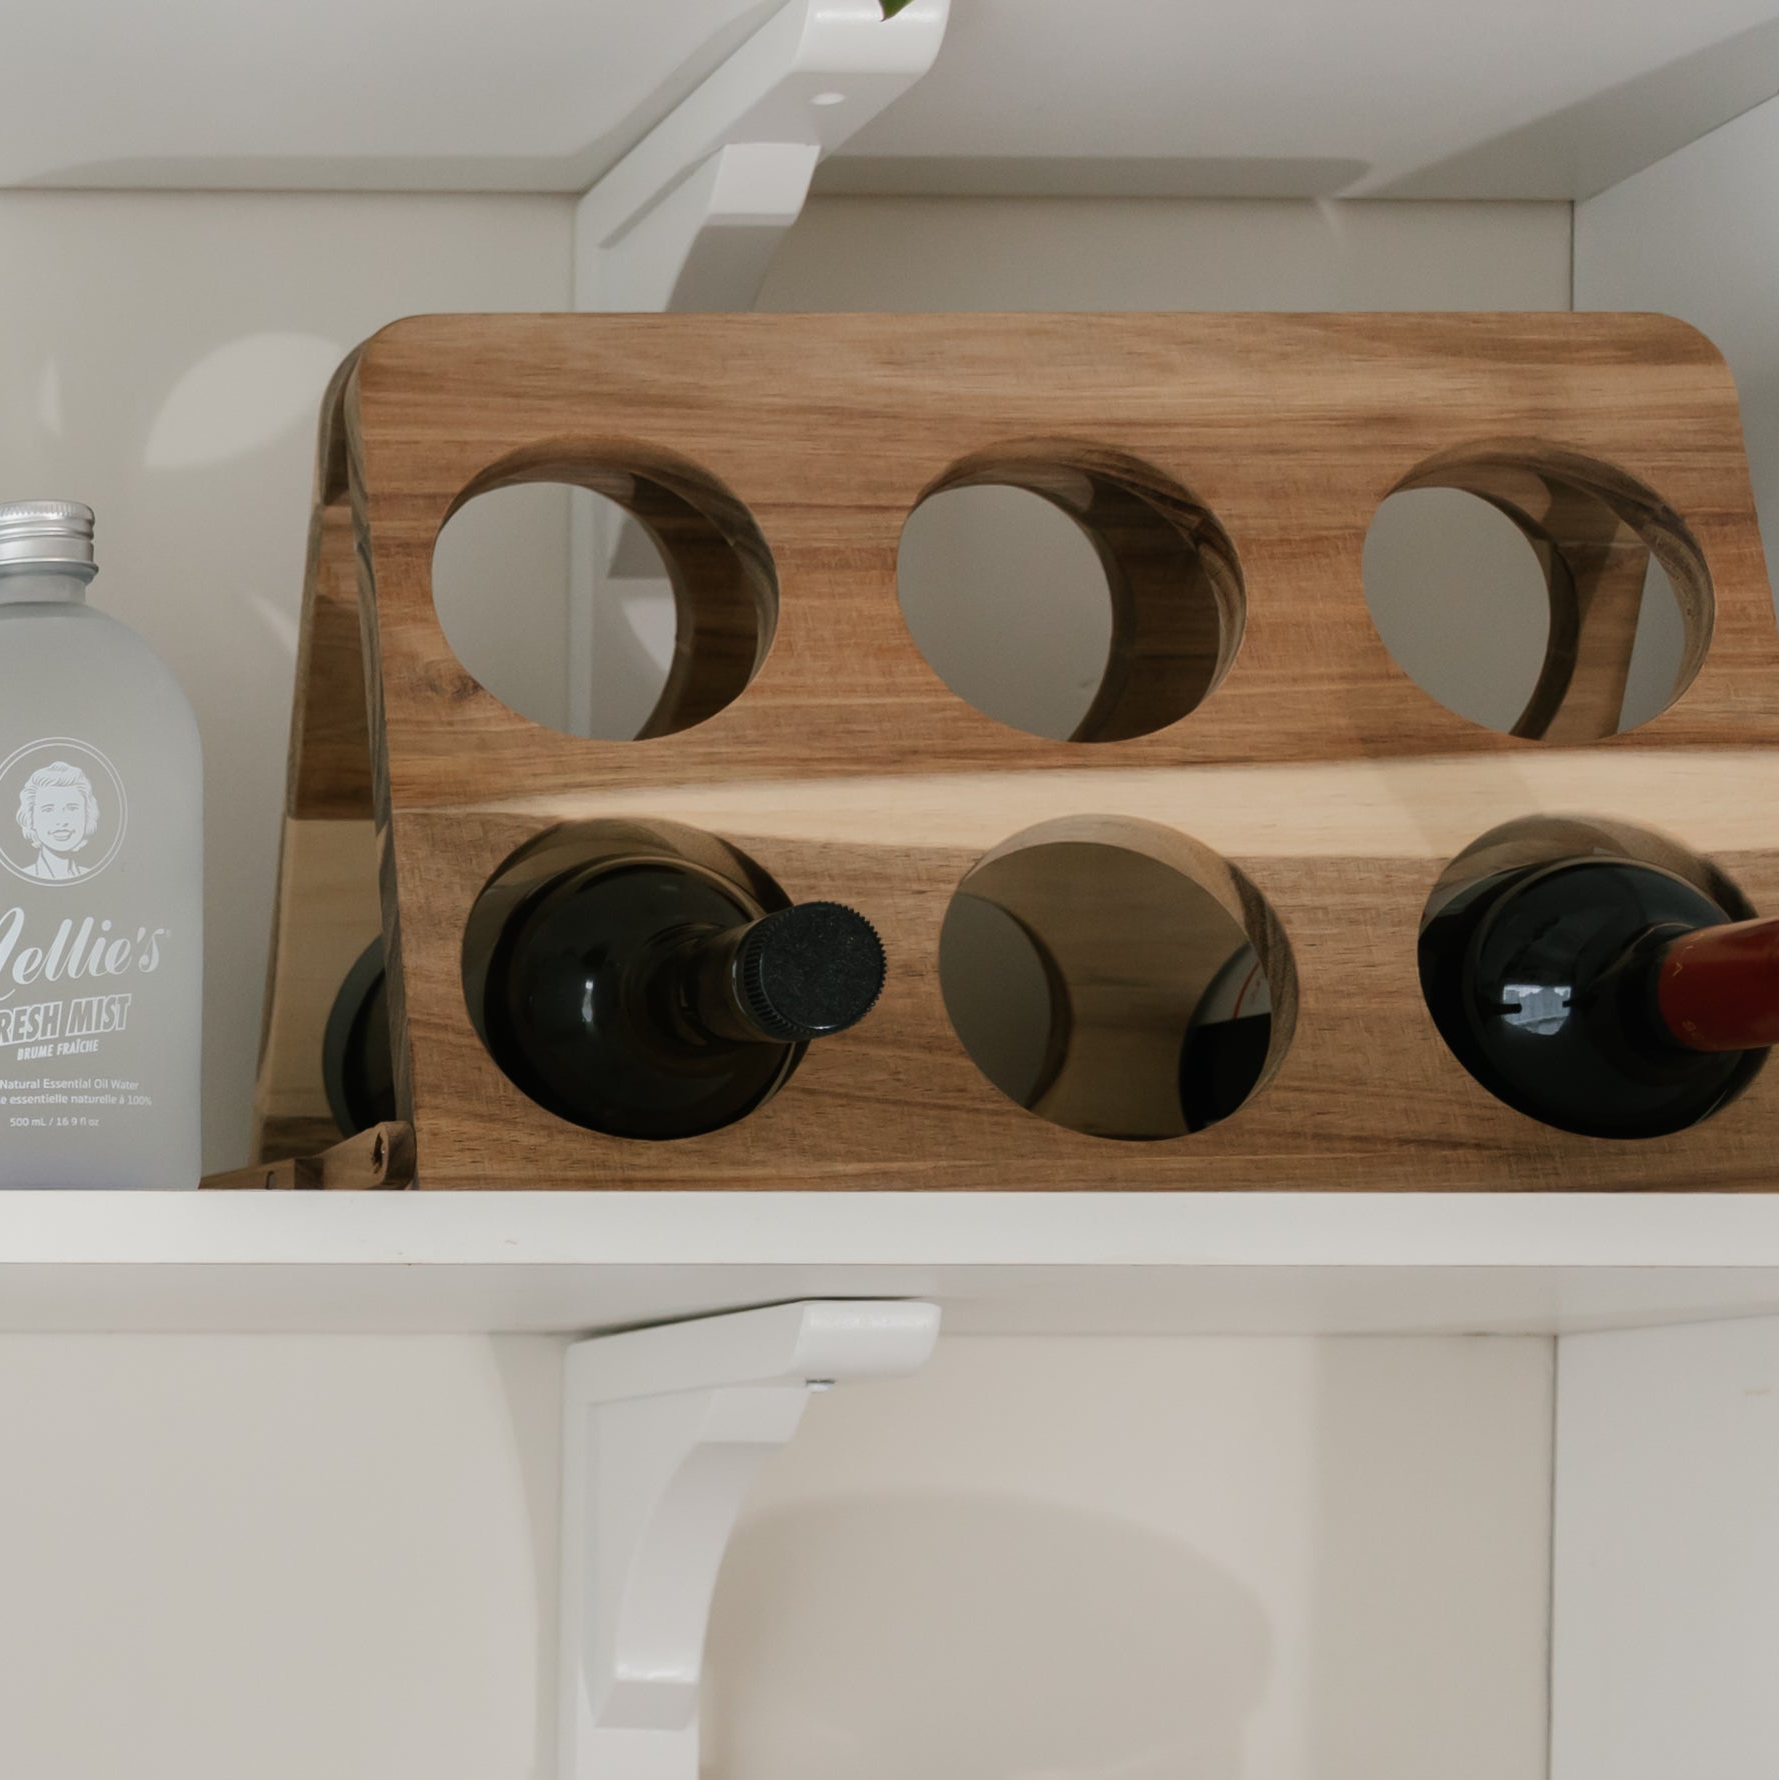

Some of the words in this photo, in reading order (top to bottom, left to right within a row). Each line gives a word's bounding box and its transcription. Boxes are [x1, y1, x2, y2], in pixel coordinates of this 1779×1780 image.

[64, 993, 133, 1037] MIST
[16, 1044, 54, 1062] BRUME
[0, 1079, 40, 1090] Natural
[43, 1078, 92, 1090] Essential
[93, 1078, 109, 1090] Oil
[110, 1080, 140, 1091] Water
[9, 1094, 68, 1105] essentielle
[70, 1094, 117, 1105] naturelle
[9, 1117, 29, 1128] 500
[31, 1117, 46, 1127] mL
